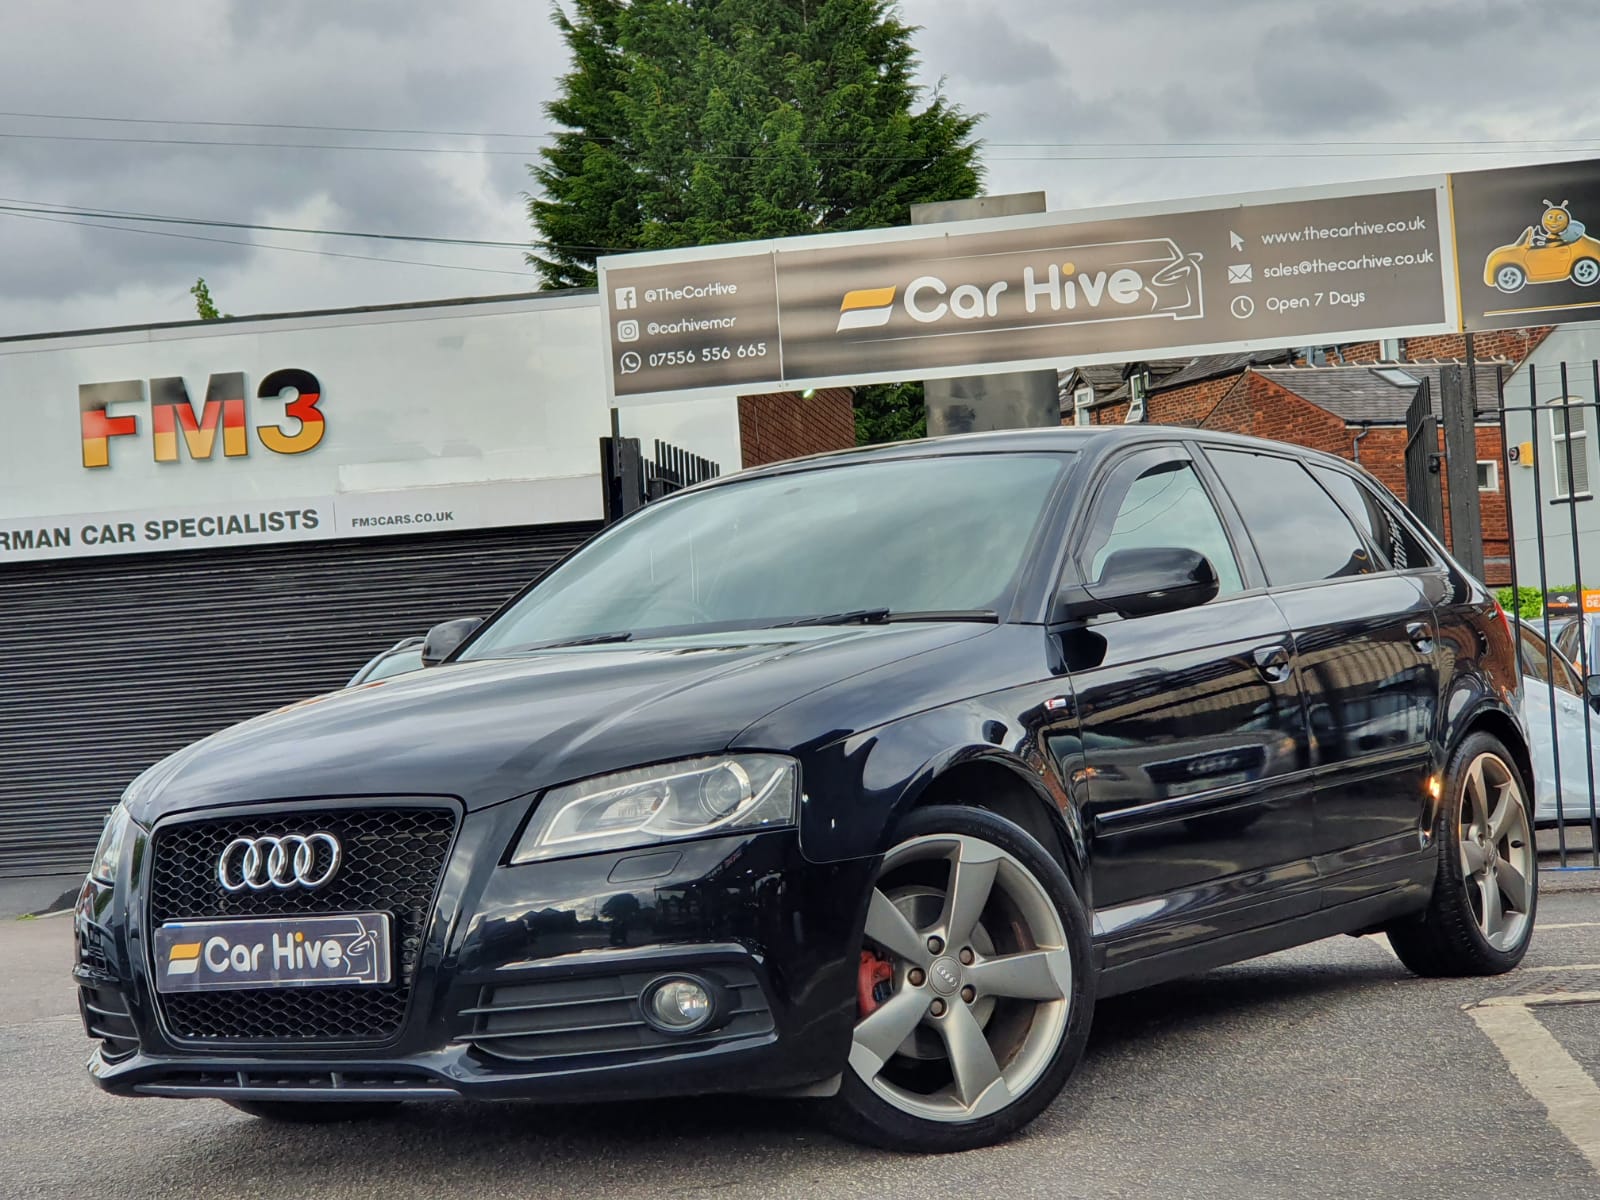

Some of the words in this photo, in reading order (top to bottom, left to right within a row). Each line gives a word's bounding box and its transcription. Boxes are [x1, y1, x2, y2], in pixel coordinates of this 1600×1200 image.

[1261, 216, 1426, 245] www.thecarhive.co.uk
[1263, 249, 1434, 278] sales@thecarhive.co.uk
[644, 282, 737, 303] @TheCarHive
[904, 276, 1008, 323] Car
[1023, 262, 1143, 313] Hive
[1266, 297, 1310, 314] Open
[1314, 293, 1324, 307] 7
[1329, 290, 1366, 307] Days
[647, 316, 736, 336] @carhivemcr
[649, 350, 696, 367] 07556
[702, 346, 731, 362] 556
[737, 343, 767, 358] 665
[78, 368, 326, 469] FM3
[0, 527, 71, 550] RMAN
[80, 523, 136, 546] CAR
[144, 509, 319, 541] SPECIALISTS
[351, 511, 454, 528] FM3CARS.CO.UK
[204, 936, 264, 973] Car
[272, 931, 343, 970] Hive
